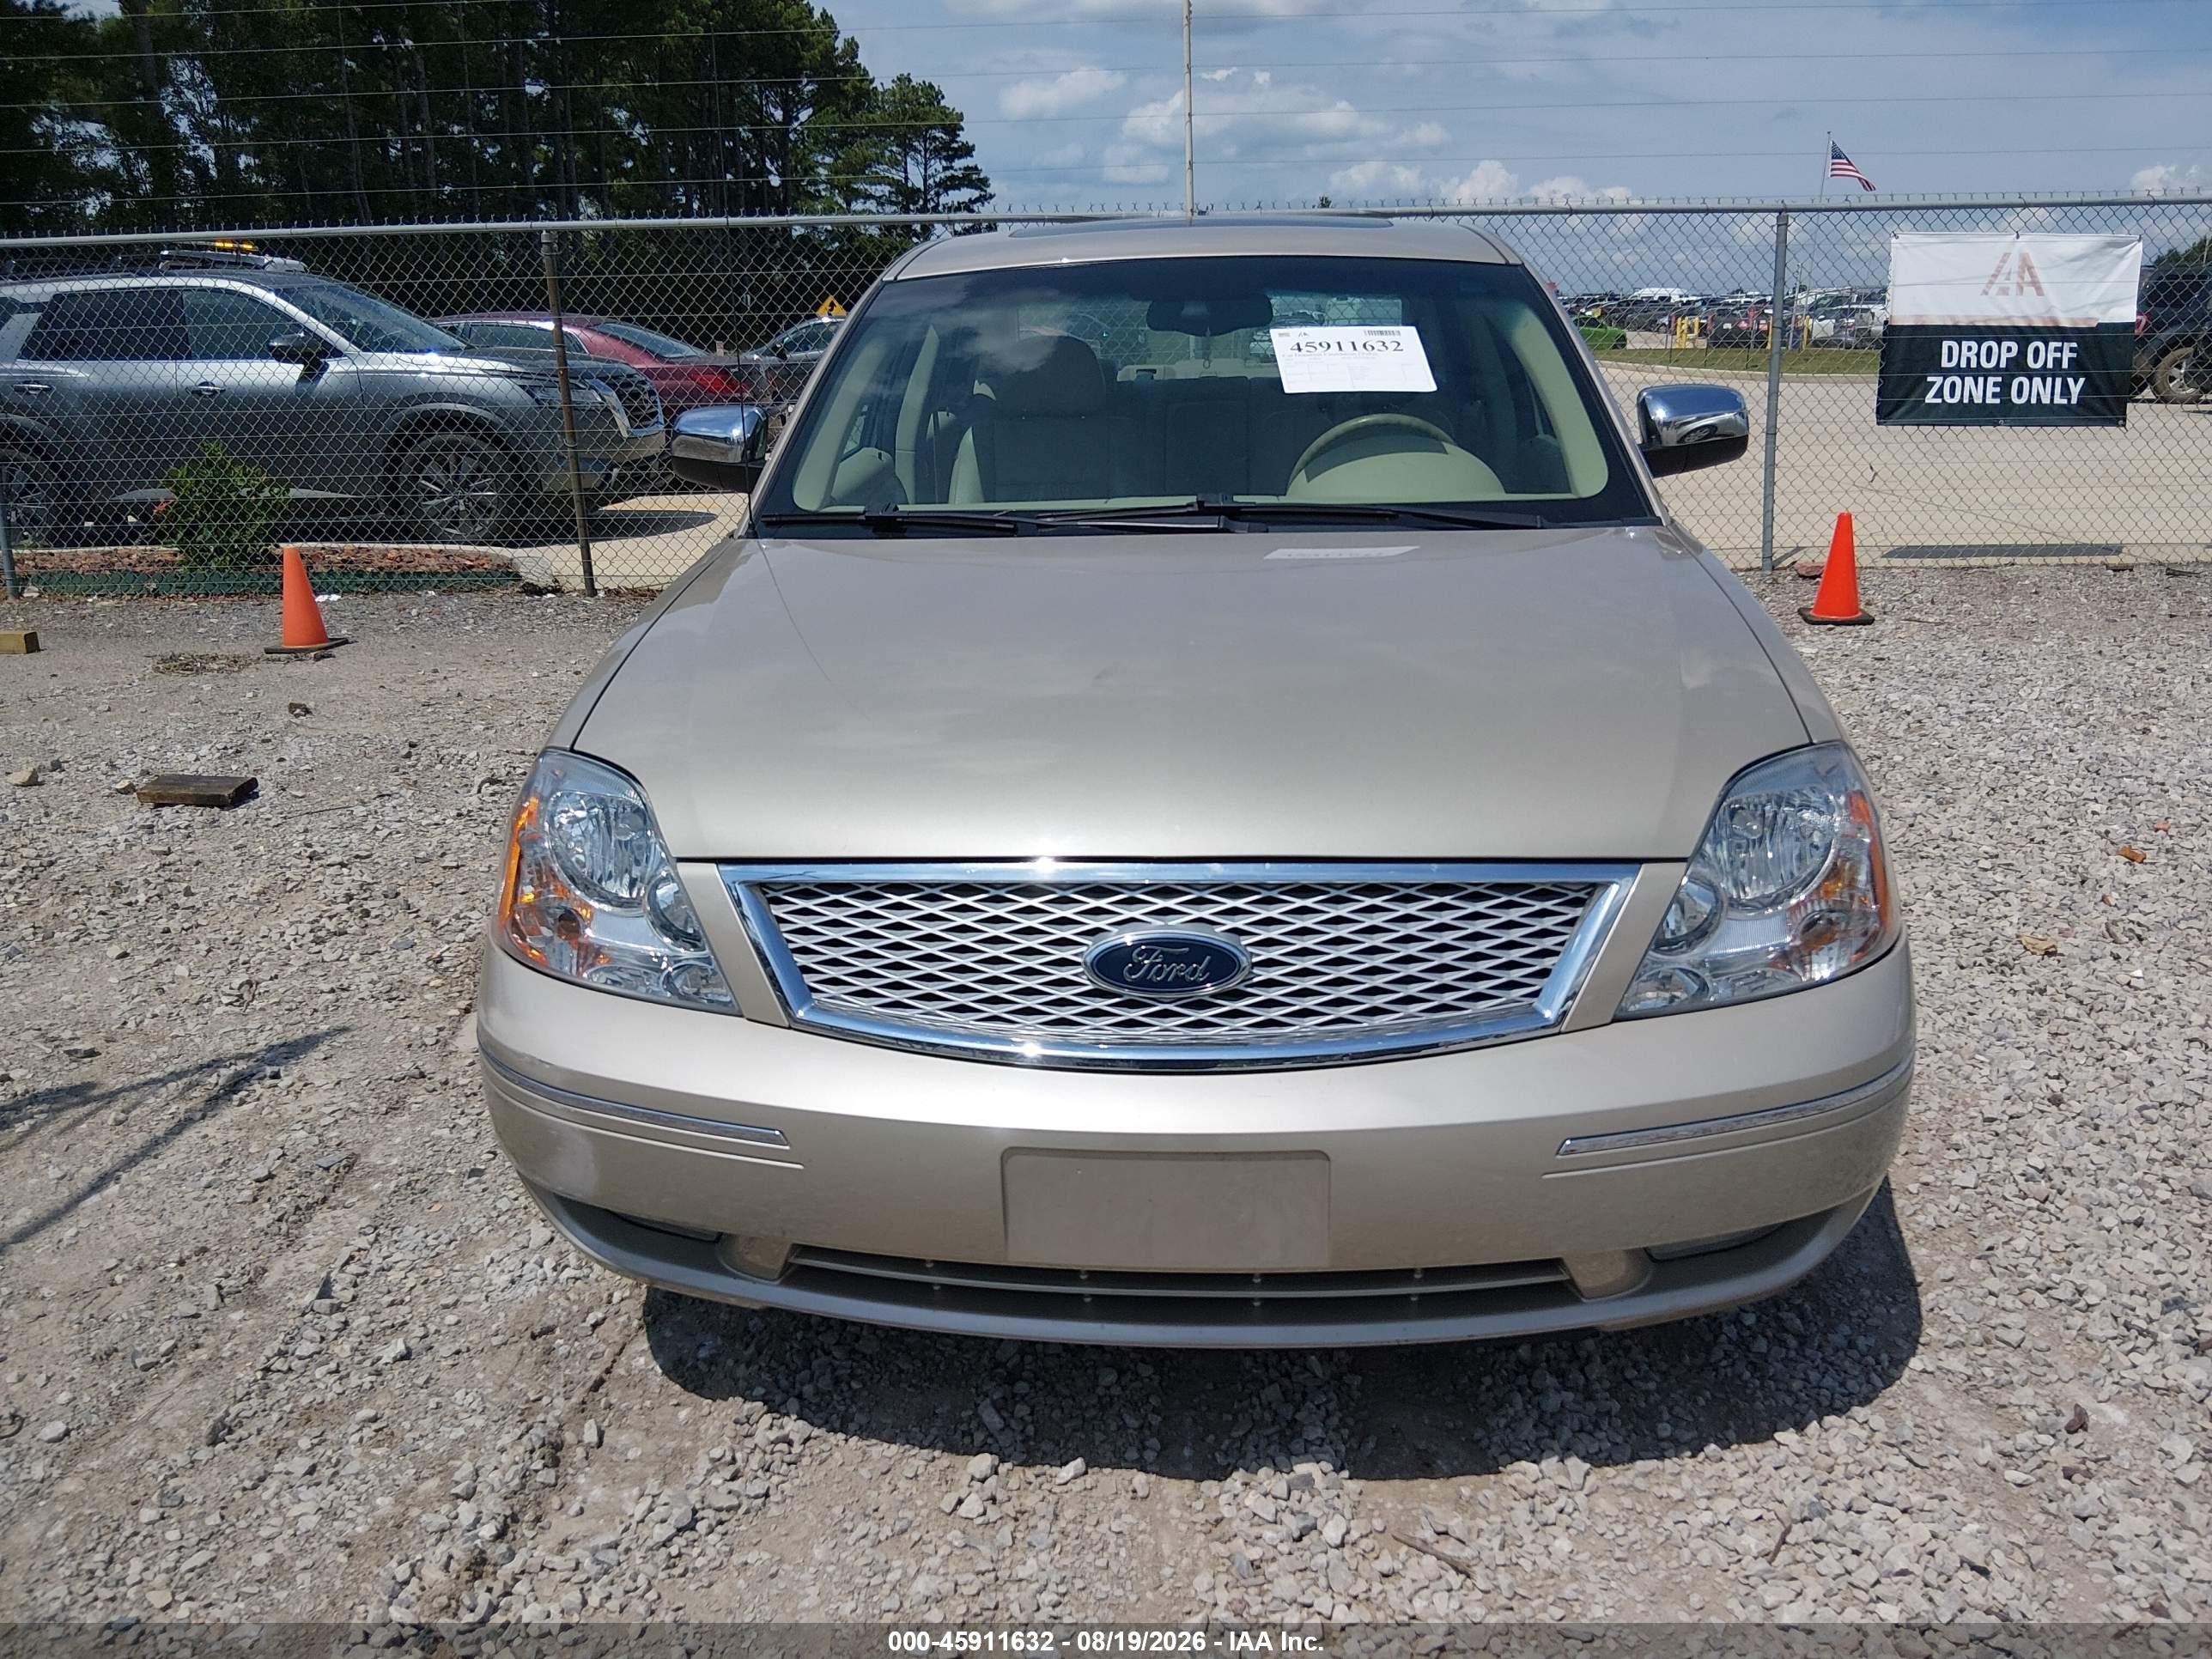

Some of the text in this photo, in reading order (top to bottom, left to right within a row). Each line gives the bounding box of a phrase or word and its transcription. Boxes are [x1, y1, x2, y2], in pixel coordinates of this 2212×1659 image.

[1290, 340, 1404, 353] 45911632
[1941, 340, 2078, 369] DROP OFF
[1924, 376, 2086, 404] ZONE ONLY
[1122, 946, 1212, 982] Ford
